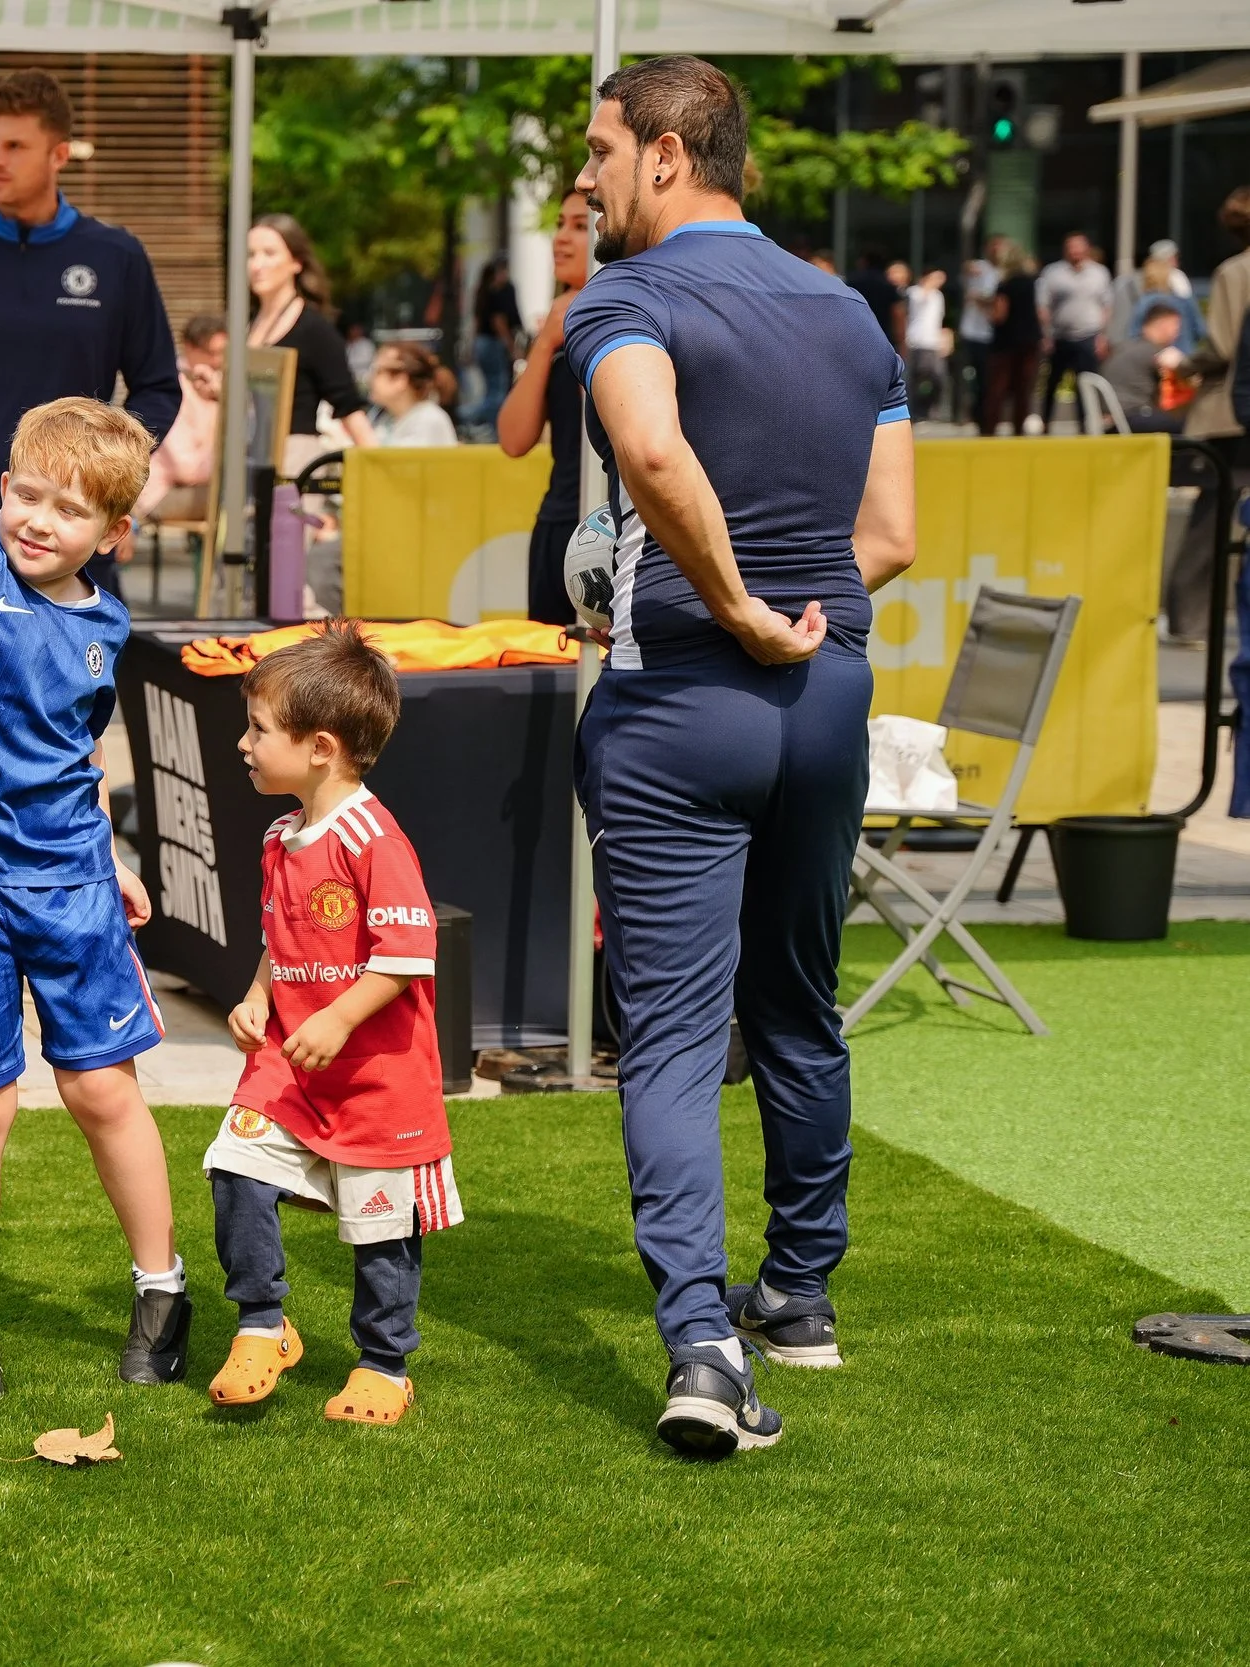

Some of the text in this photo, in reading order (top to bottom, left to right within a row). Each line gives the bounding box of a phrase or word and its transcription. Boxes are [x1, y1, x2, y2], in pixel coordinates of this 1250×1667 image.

[143, 681, 206, 787] HAM
[159, 841, 228, 948] SMITH
[311, 883, 353, 899] MANCHESTER
[321, 915, 348, 925] UNITED
[270, 959, 368, 984] TeamViewe
[360, 1203, 395, 1214] adidas
